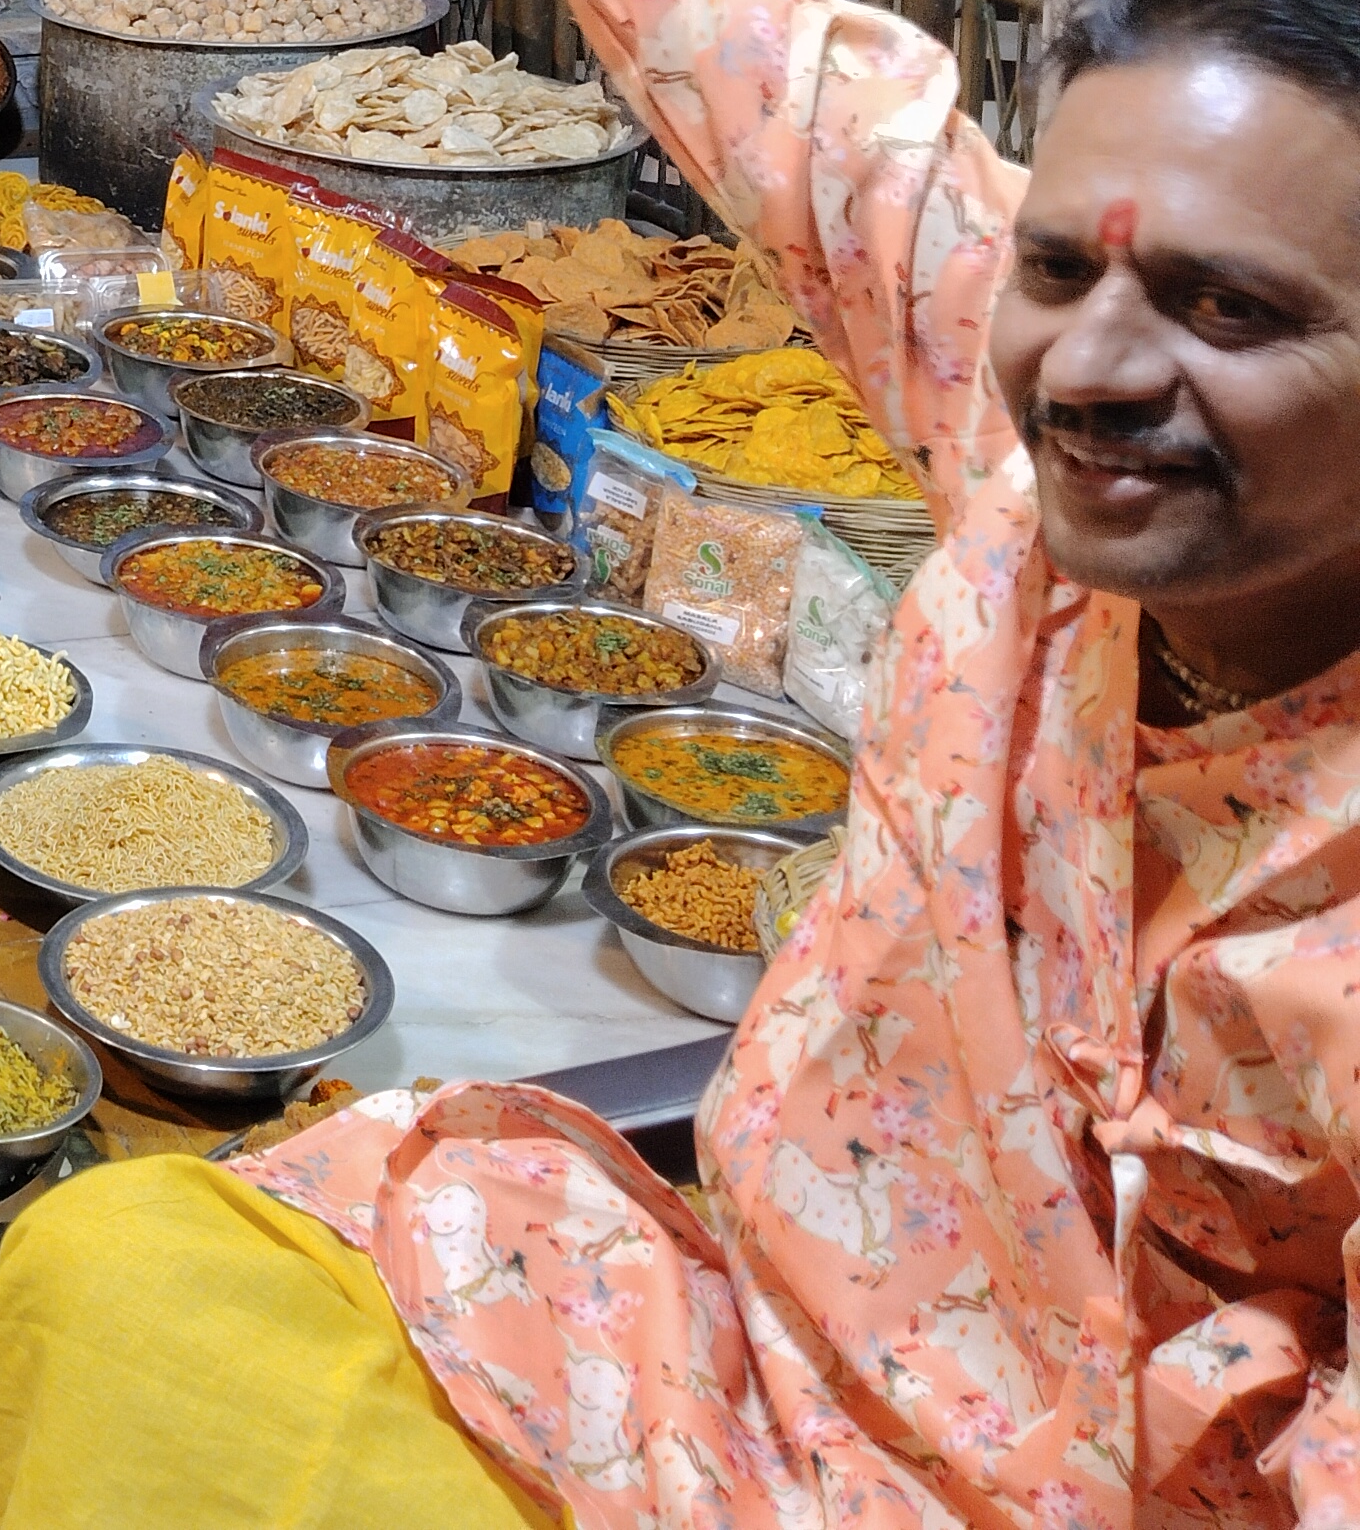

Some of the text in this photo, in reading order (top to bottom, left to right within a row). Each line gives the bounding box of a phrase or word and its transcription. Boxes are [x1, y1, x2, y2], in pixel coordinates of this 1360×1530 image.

[235, 226, 282, 246] sweets
[365, 301, 410, 322] sweets
[445, 369, 496, 393] sweets
[545, 383, 573, 412] lanki
